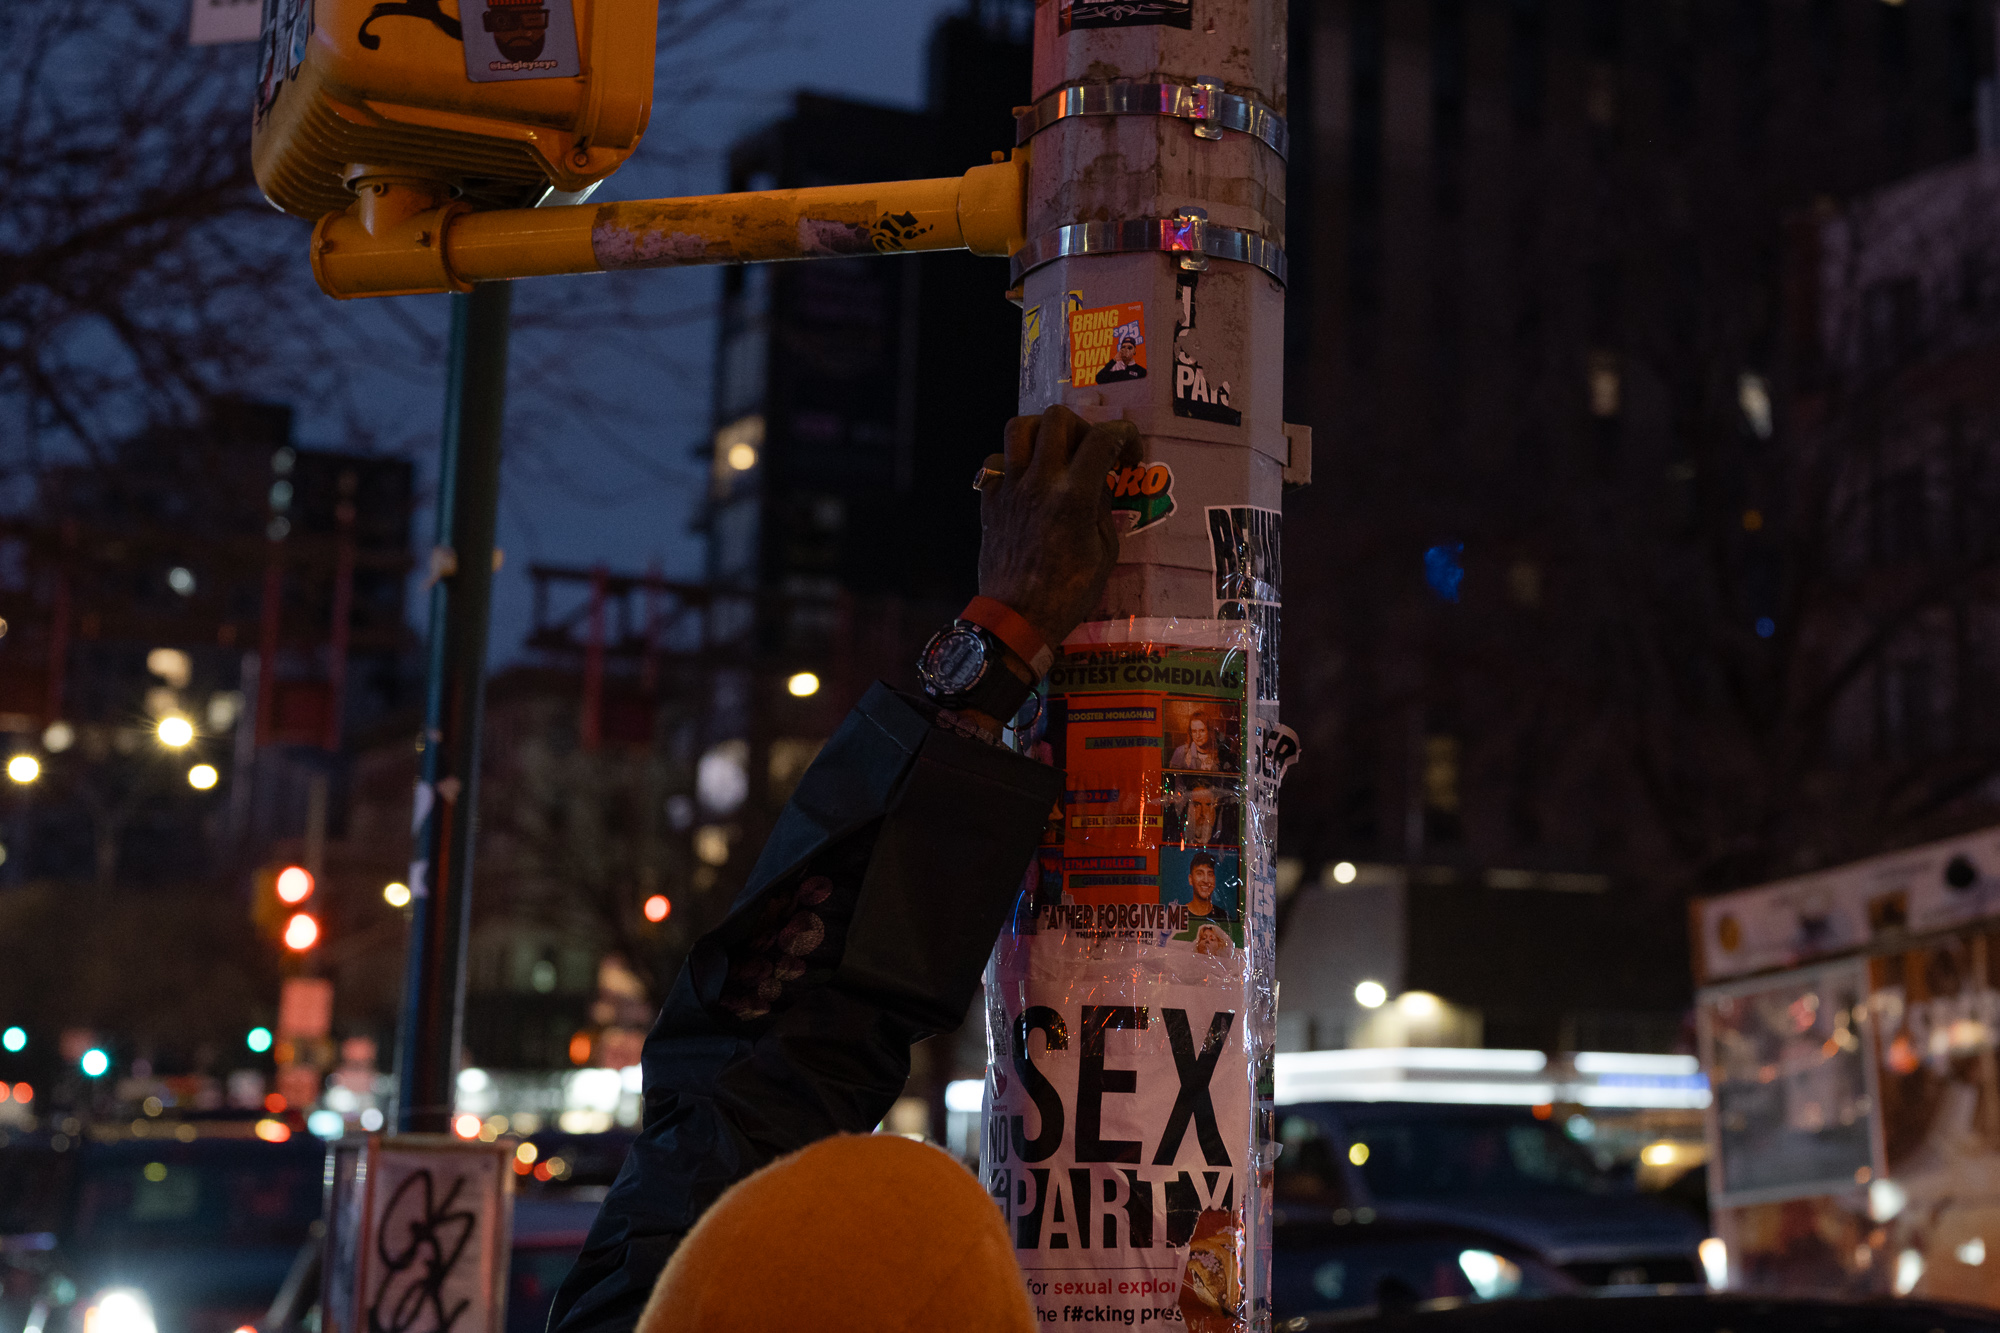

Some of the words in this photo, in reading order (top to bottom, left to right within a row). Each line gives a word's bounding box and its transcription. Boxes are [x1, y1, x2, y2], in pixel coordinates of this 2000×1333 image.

[489, 60, 558, 72] @langleyseye
[1072, 309, 1119, 333] BRING
[1074, 327, 1114, 350] YOUR
[1074, 346, 1111, 368] OWN
[1050, 666, 1119, 687] OTTEST
[1123, 666, 1240, 689] COMEDIANS
[1068, 712, 1104, 721] ROOSTER
[1105, 710, 1155, 720] MONAGHAN
[1093, 739, 1113, 747] ANN
[1116, 738, 1135, 747] VAN
[1137, 737, 1159, 747] EPPS
[1042, 903, 1095, 930] FATHER
[1097, 903, 1165, 930] FORGIVE
[1167, 905, 1189, 930] ME
[1076, 931, 1116, 939] THURSDAY
[1011, 1005, 1235, 1167] SEX
[1010, 1168, 1234, 1250] PARTY
[1026, 1278, 1049, 1295] for
[1054, 1278, 1112, 1295] sexual
[1036, 1305, 1058, 1322] he
[1063, 1305, 1135, 1326] f#cking
